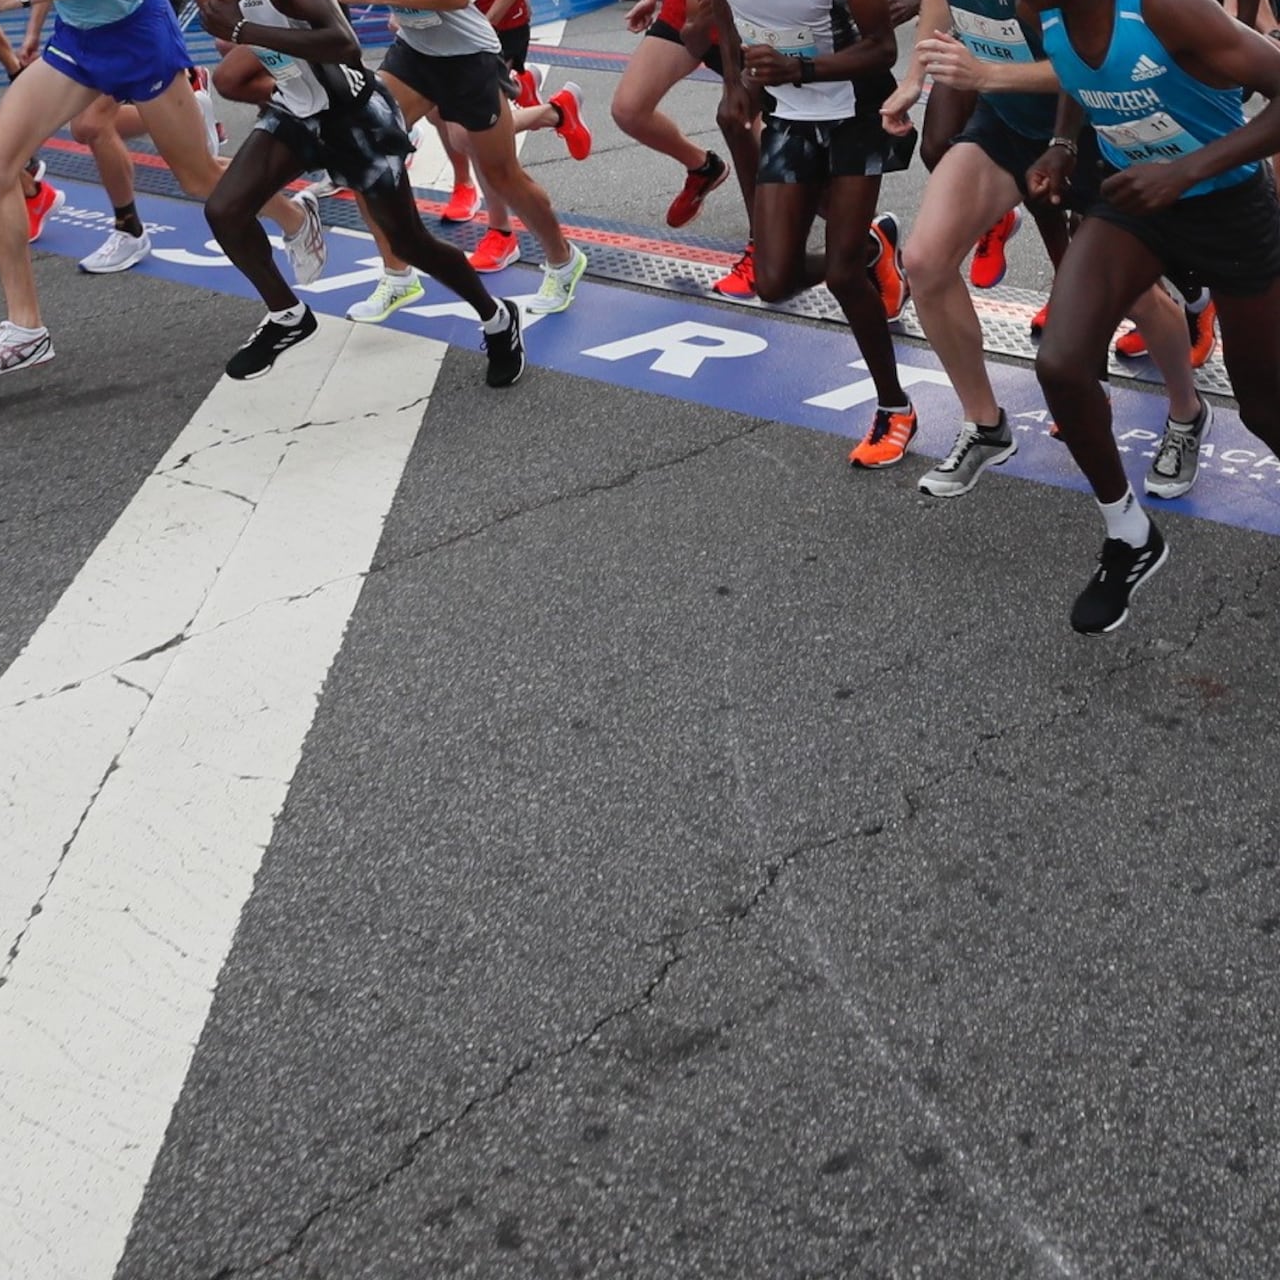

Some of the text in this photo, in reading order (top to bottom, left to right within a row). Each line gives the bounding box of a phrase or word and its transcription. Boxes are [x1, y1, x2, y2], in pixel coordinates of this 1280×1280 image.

[1001, 26, 1015, 36] 21
[970, 40, 1014, 60] TYLER
[1130, 65, 1168, 82] adidas
[1151, 120, 1169, 131] 11
[1123, 143, 1183, 161] BRAVIN
